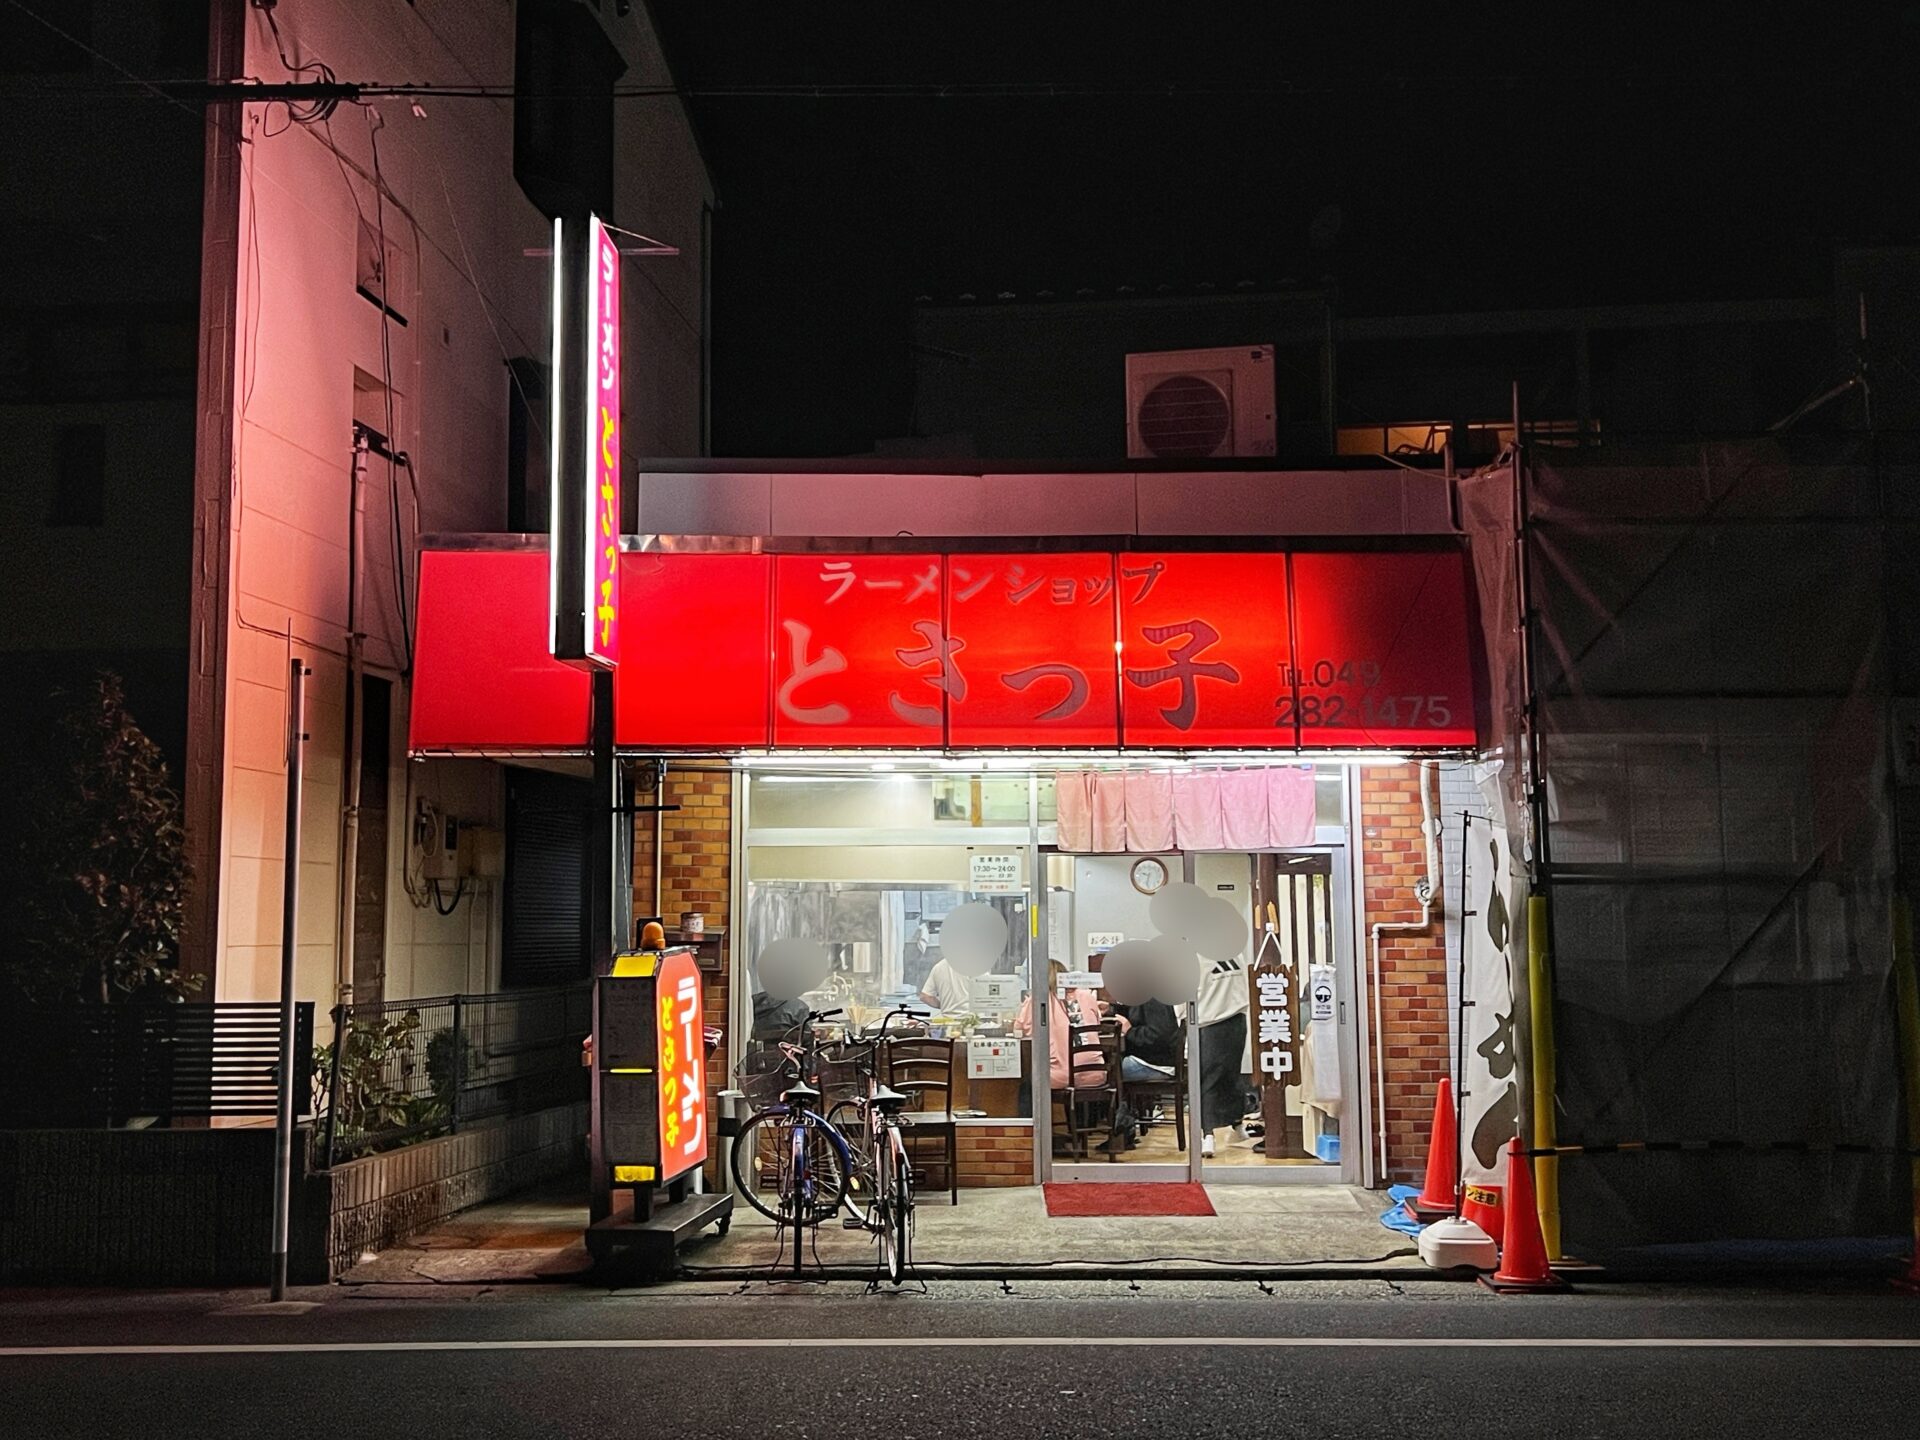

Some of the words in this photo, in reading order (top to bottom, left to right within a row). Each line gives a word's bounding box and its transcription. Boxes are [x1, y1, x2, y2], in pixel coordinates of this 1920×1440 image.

[818, 560, 1167, 606] ラーメンショップ
[677, 976, 703, 1155] ラーメン
[1256, 972, 1294, 1081] 営業中
